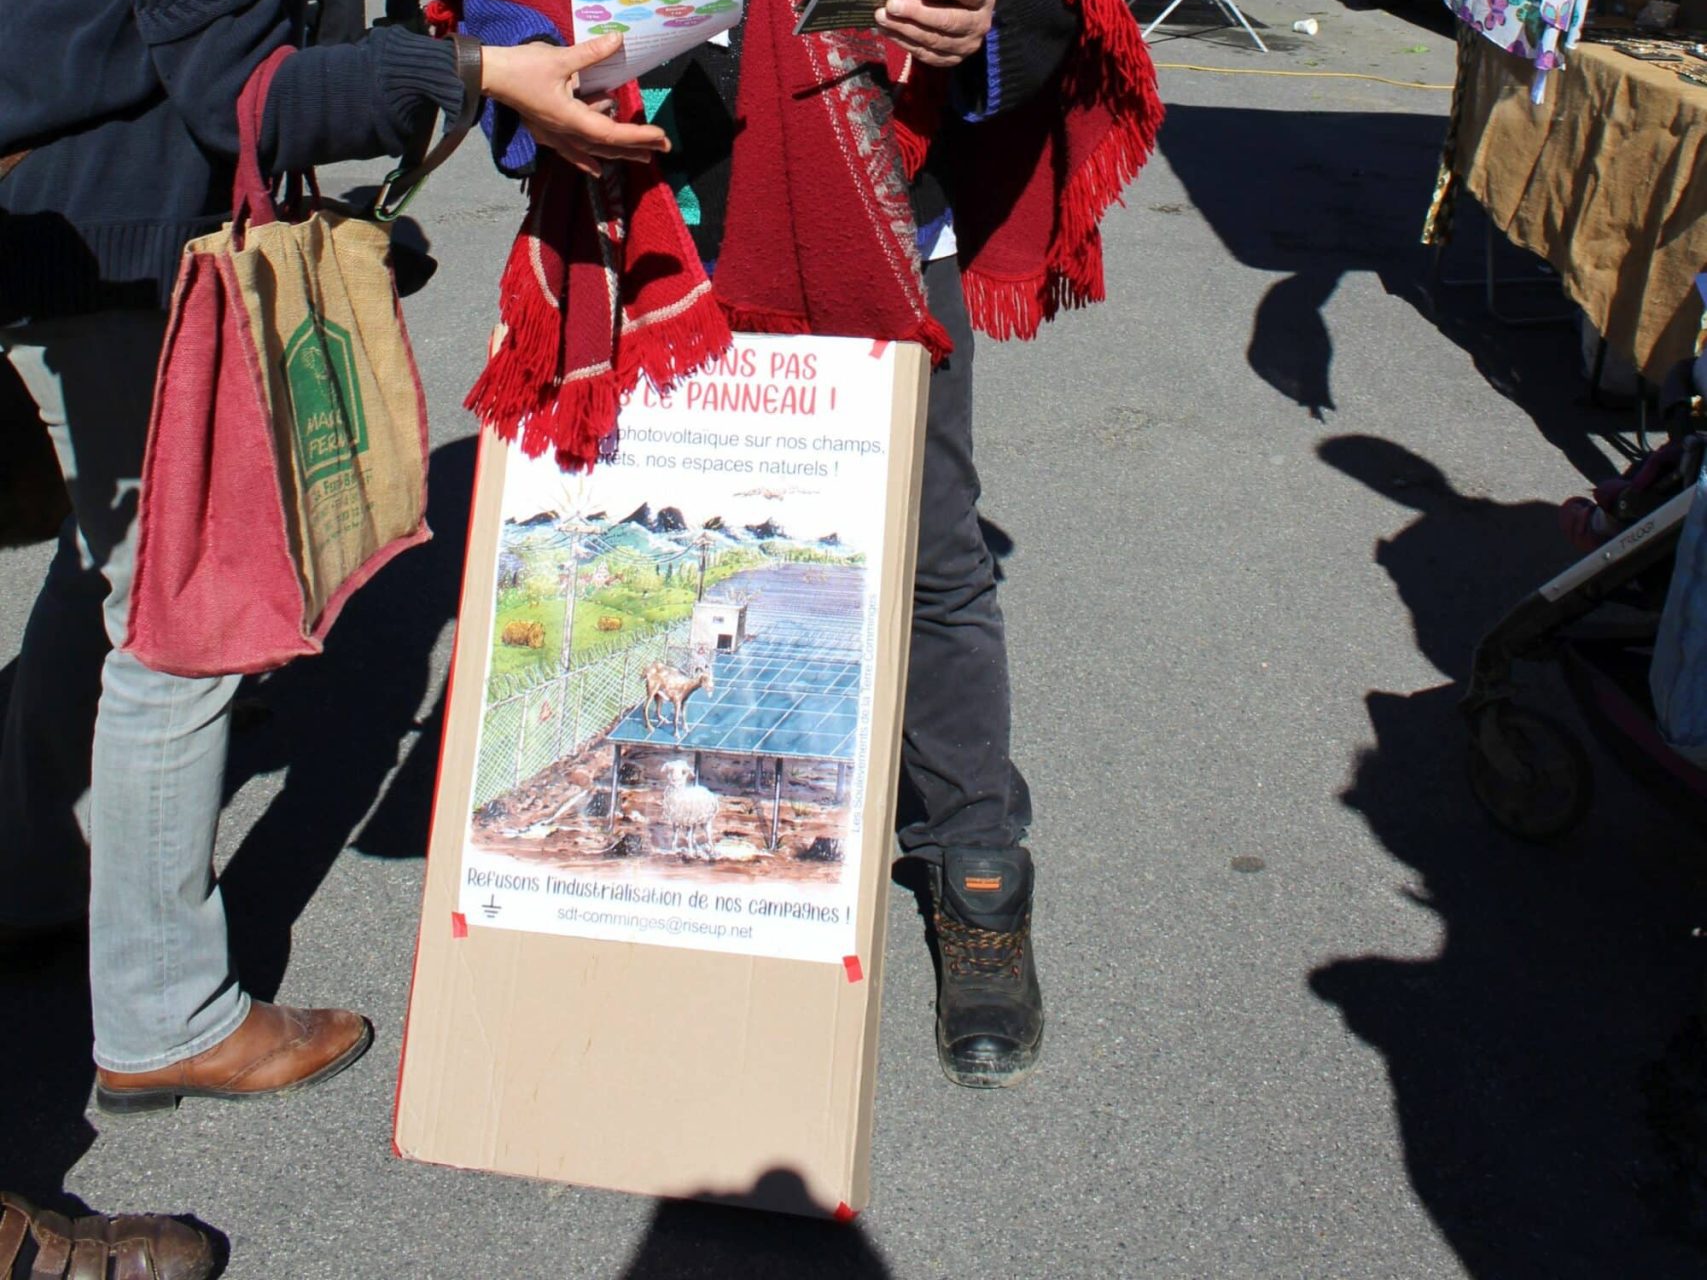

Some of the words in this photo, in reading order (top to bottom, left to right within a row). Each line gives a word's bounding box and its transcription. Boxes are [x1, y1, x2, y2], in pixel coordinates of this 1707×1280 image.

[771, 351, 817, 380] PAS
[687, 381, 817, 415] PANNEAU
[617, 425, 739, 448] photovoltaïque
[744, 434, 771, 448] sur
[776, 436, 807, 450] nos
[812, 435, 885, 456] champs,
[646, 454, 676, 469] nos
[682, 456, 754, 474] espaces
[759, 459, 828, 477] naturels
[834, 460, 839, 477] !
[862, 664, 873, 693] Terre
[860, 709, 870, 725] de
[851, 811, 862, 834] Les
[467, 867, 540, 892] Refusons
[546, 875, 682, 907] l'industrialisation
[688, 889, 709, 910] de
[715, 895, 742, 913] nos
[748, 898, 840, 924] campagnes
[845, 905, 851, 925] !
[557, 906, 753, 939] sdt-comminges@riseup.net
